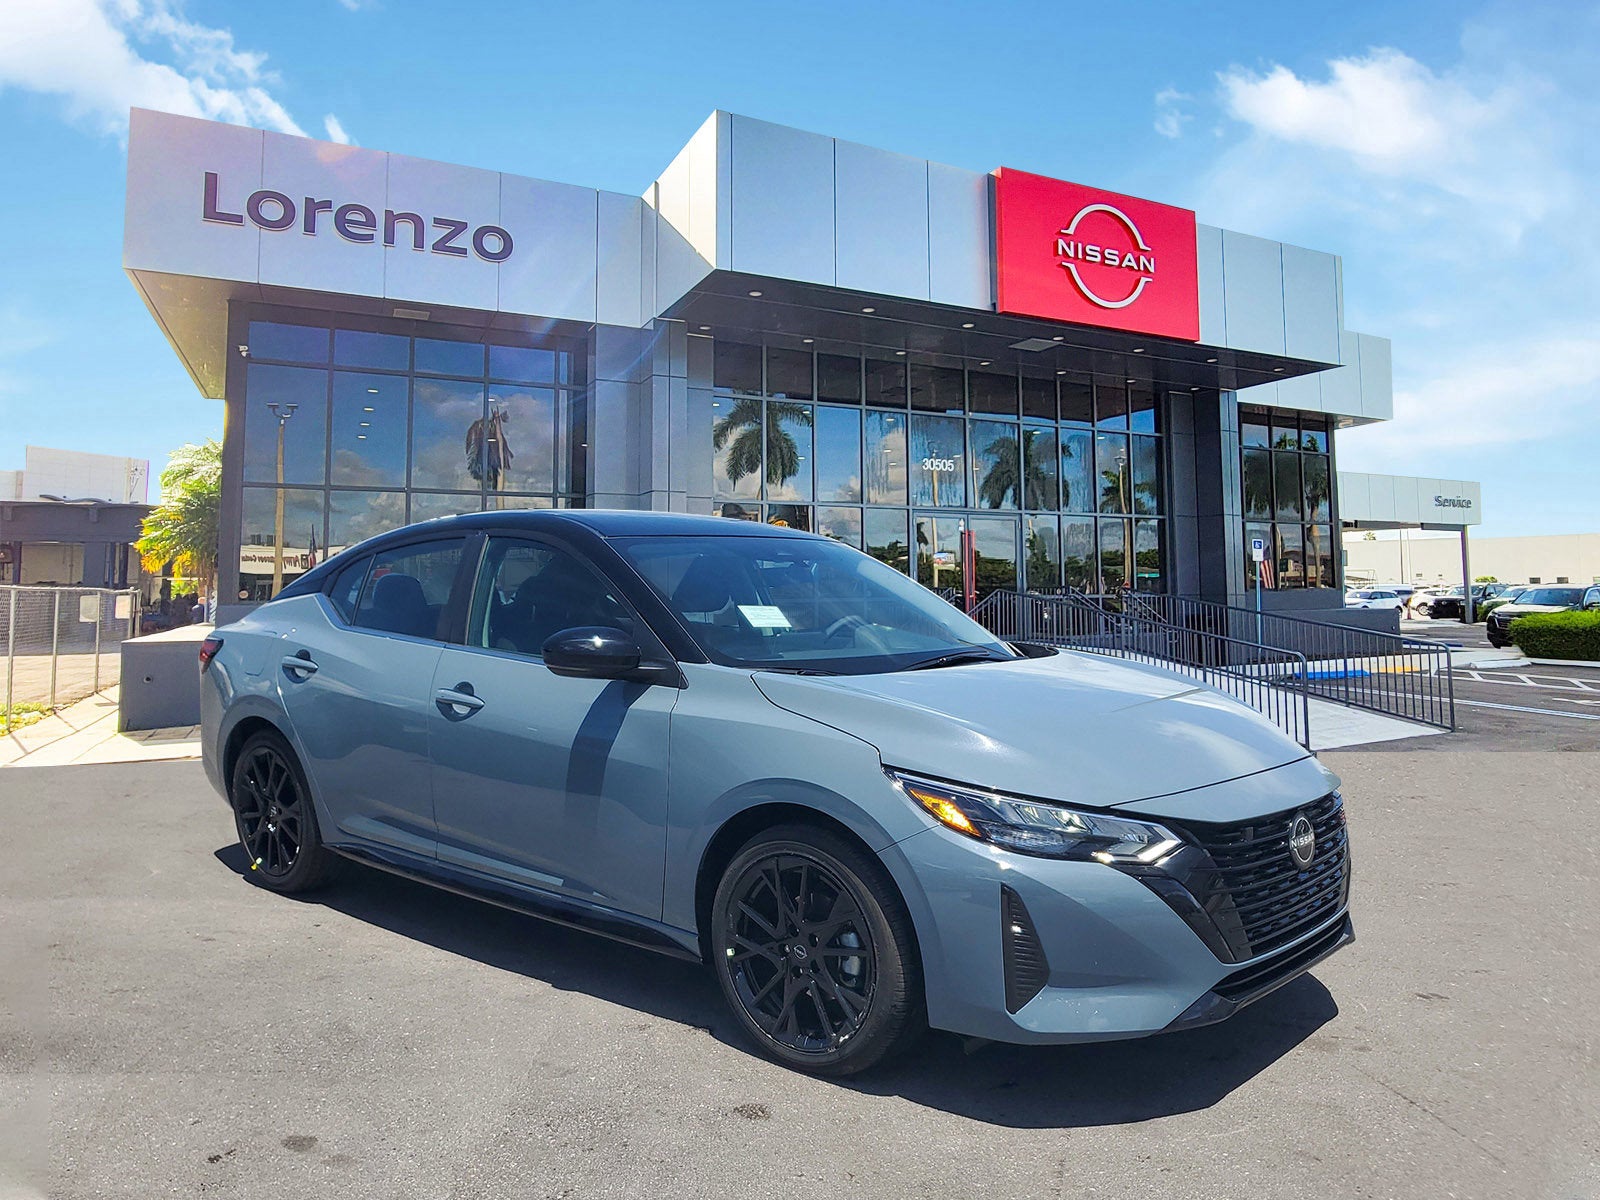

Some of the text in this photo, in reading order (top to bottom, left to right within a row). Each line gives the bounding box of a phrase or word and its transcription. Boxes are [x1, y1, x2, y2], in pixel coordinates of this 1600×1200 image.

[203, 172, 514, 262] Lorenzo
[1057, 238, 1155, 273] NISSAN
[922, 457, 954, 471] 30505
[1434, 495, 1472, 508] Service
